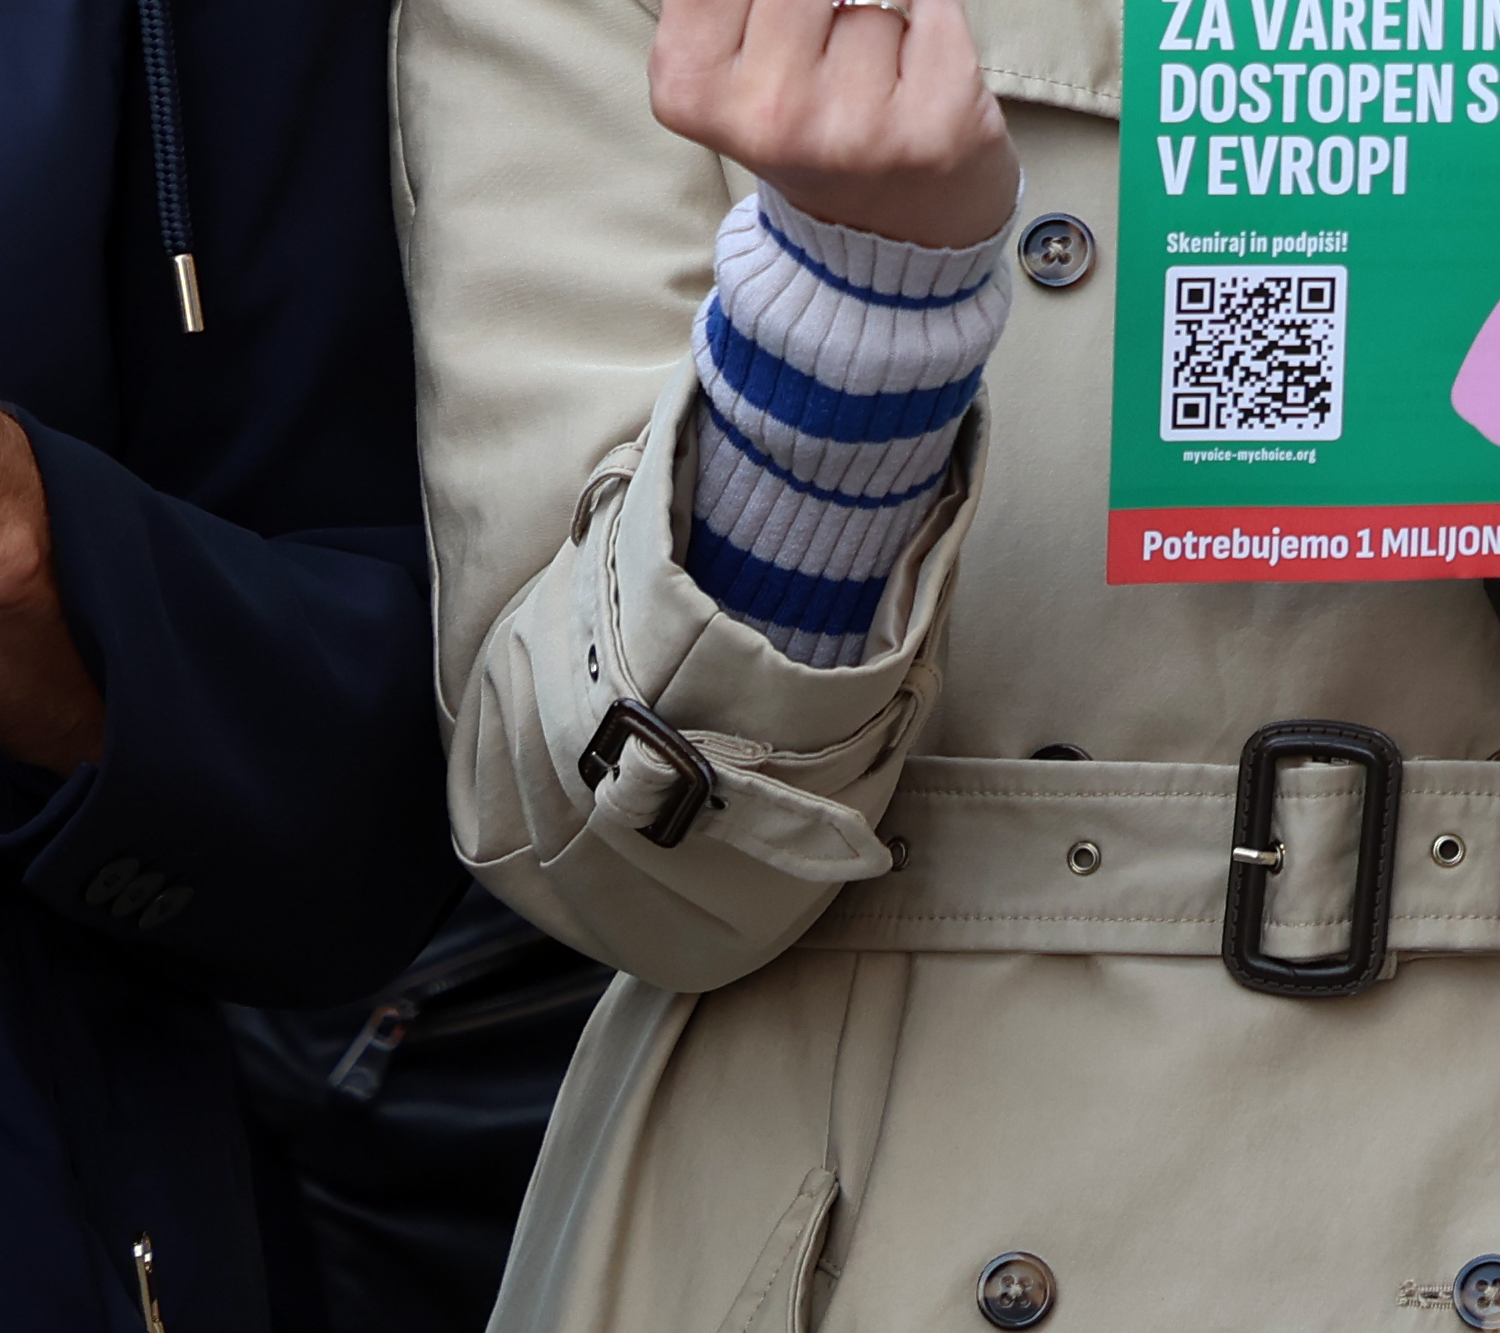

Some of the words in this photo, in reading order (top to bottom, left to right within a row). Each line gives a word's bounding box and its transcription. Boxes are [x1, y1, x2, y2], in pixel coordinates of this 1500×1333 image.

[1159, 62, 1452, 124] DOSTOPEN
[1157, 136, 1195, 195] V
[1207, 136, 1407, 196] EVROPI
[1166, 231, 1246, 259] Skeniraj
[1250, 232, 1268, 253] in
[1272, 231, 1348, 259] podpiši!
[1183, 445, 1317, 465] myvoice-mychoice.org
[1142, 528, 1349, 566] Potrebujemo
[1355, 528, 1375, 559] 1
